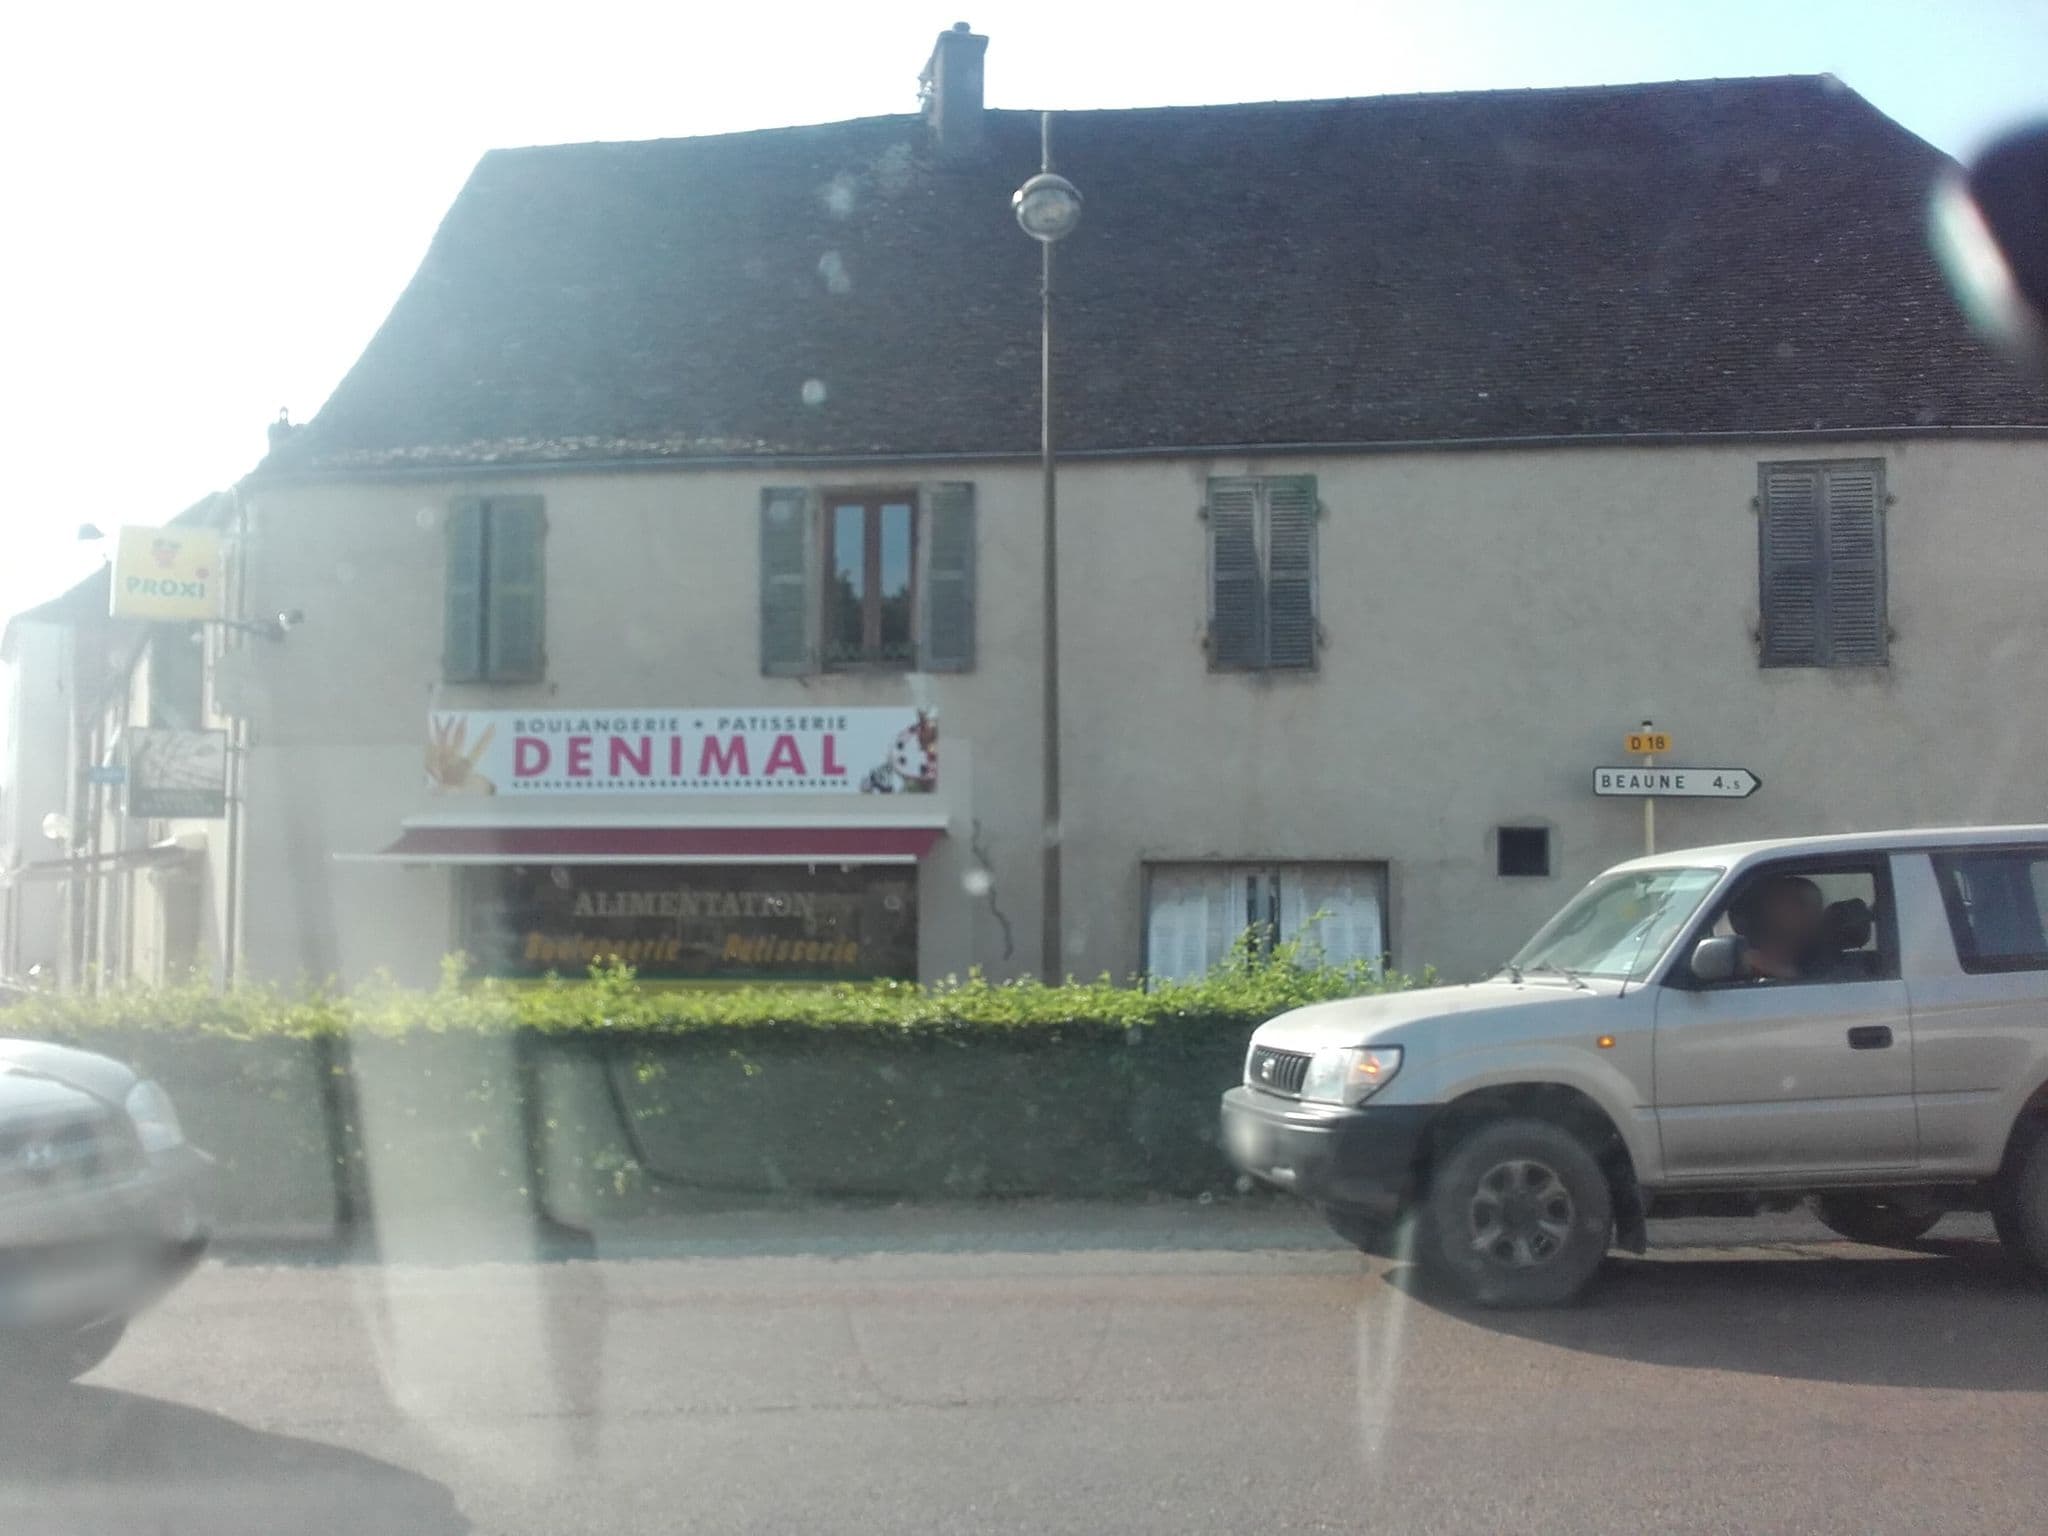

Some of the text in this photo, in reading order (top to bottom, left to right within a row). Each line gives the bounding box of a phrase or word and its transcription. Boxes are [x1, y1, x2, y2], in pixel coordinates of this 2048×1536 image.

[127, 577, 205, 599] PROXI
[513, 715, 847, 733] BOULANGERIE PATISSERIE
[1631, 735, 1665, 750] D 18
[514, 734, 847, 777] DENIMAL
[1601, 774, 1685, 789] BEAUNE
[575, 890, 815, 918] ALIMENTATION
